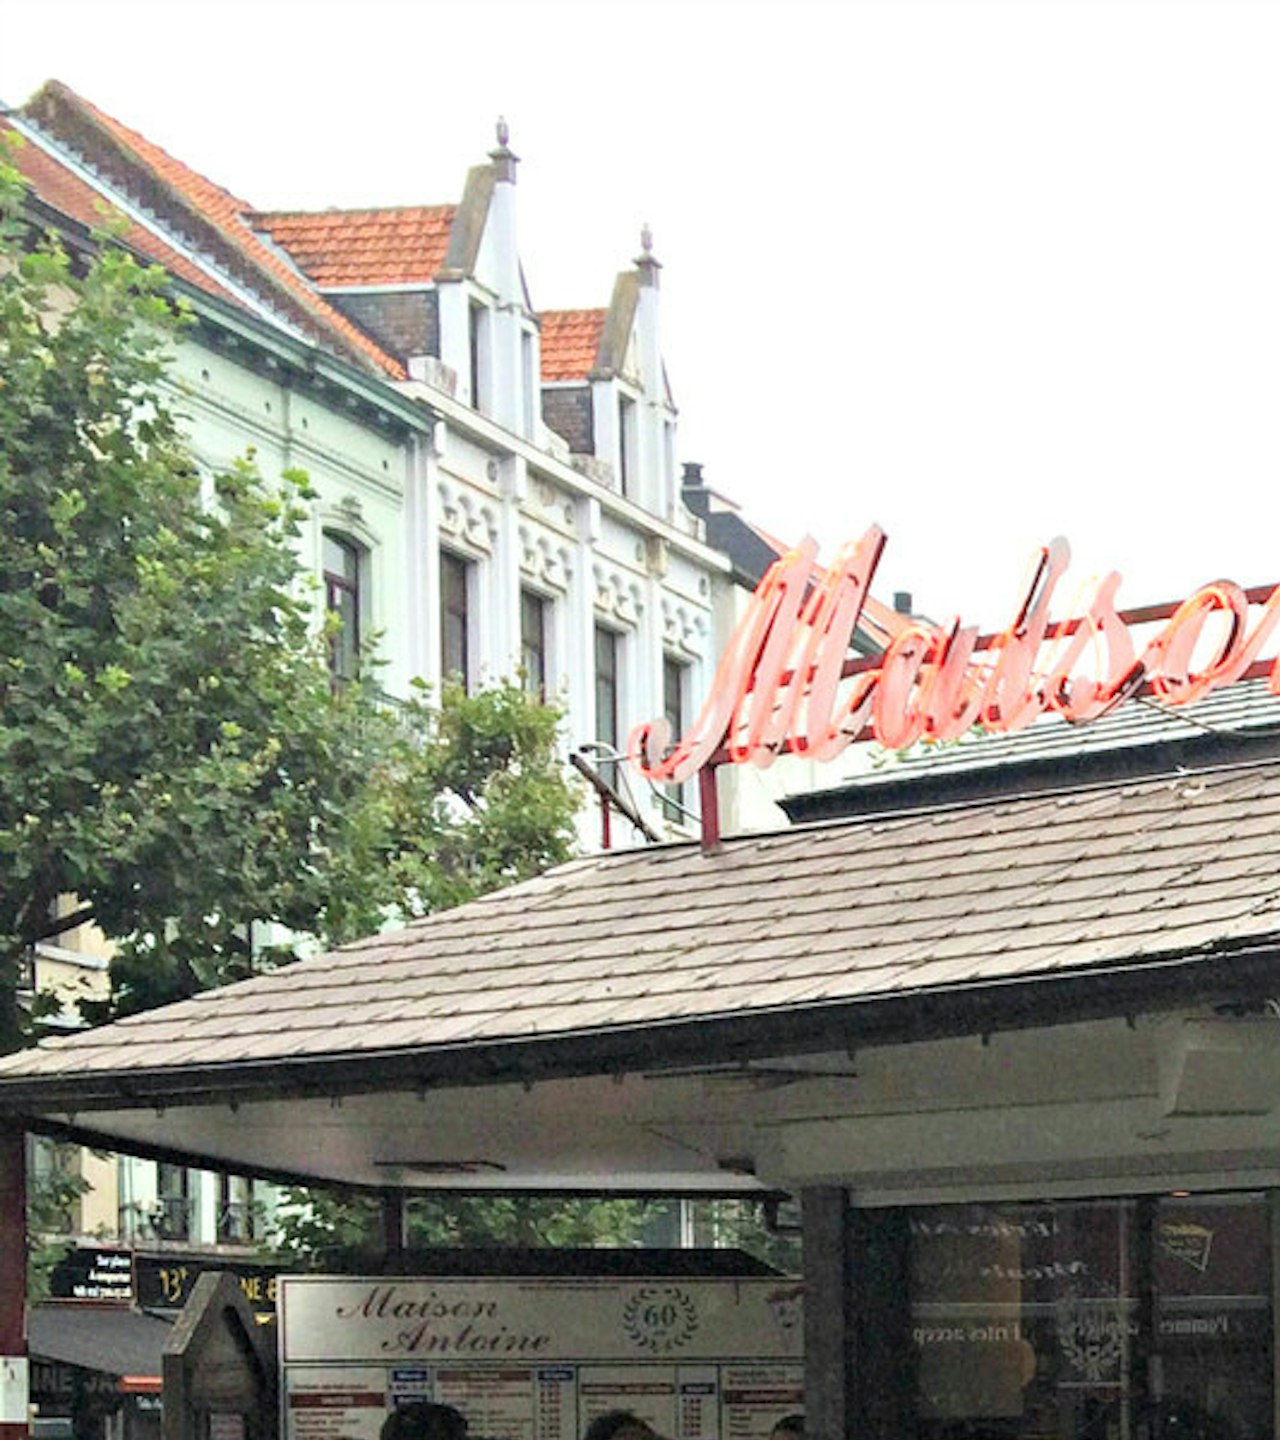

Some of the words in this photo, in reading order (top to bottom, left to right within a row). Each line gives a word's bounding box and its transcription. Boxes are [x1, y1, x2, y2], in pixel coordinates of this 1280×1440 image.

[336, 1286, 498, 1319] Maison
[643, 1304, 678, 1328] 60
[381, 1321, 550, 1352] Antoine
